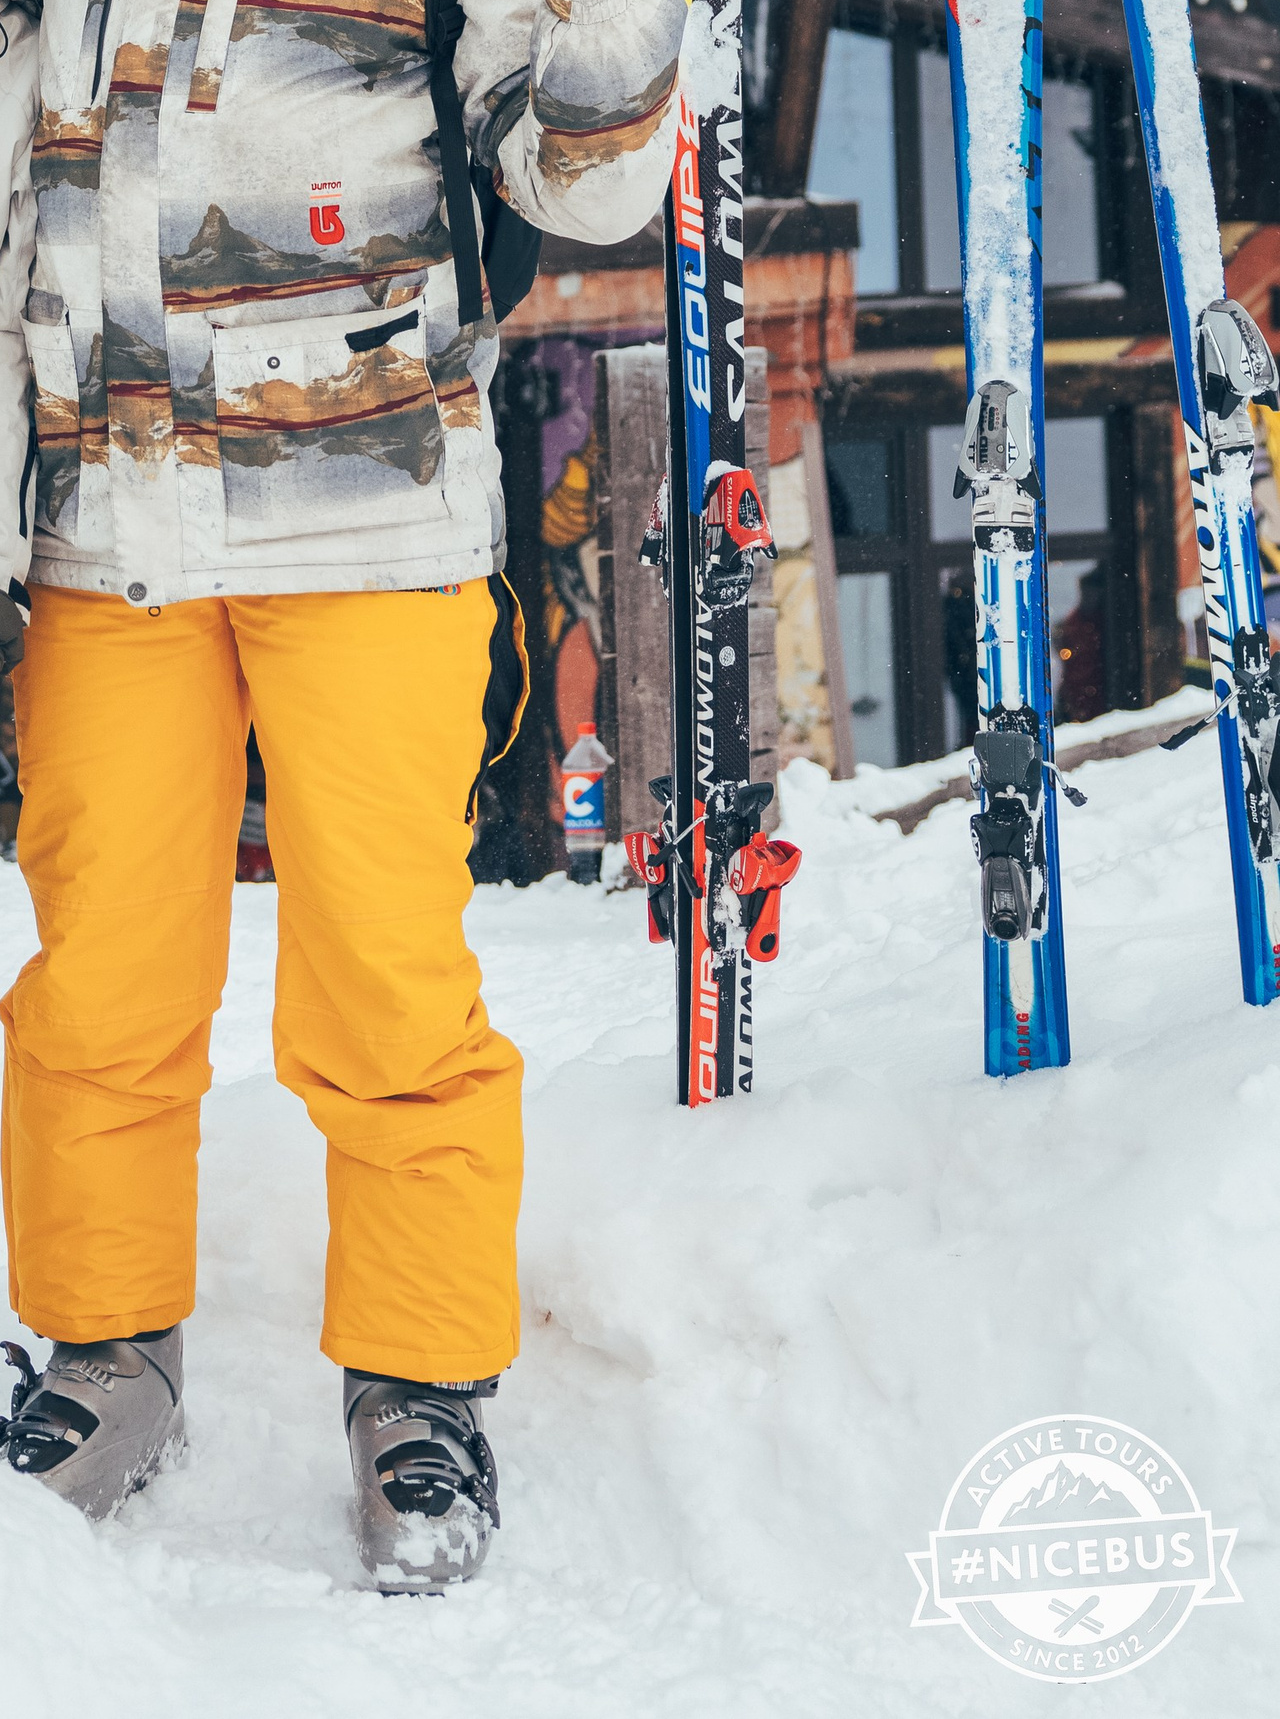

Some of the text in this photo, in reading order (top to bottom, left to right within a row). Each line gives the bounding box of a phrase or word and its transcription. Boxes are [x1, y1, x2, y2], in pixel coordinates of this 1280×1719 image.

[726, 475, 734, 530] SALOMON
[1183, 420, 1238, 721] ATOMIC
[694, 564, 715, 789] SALOMON
